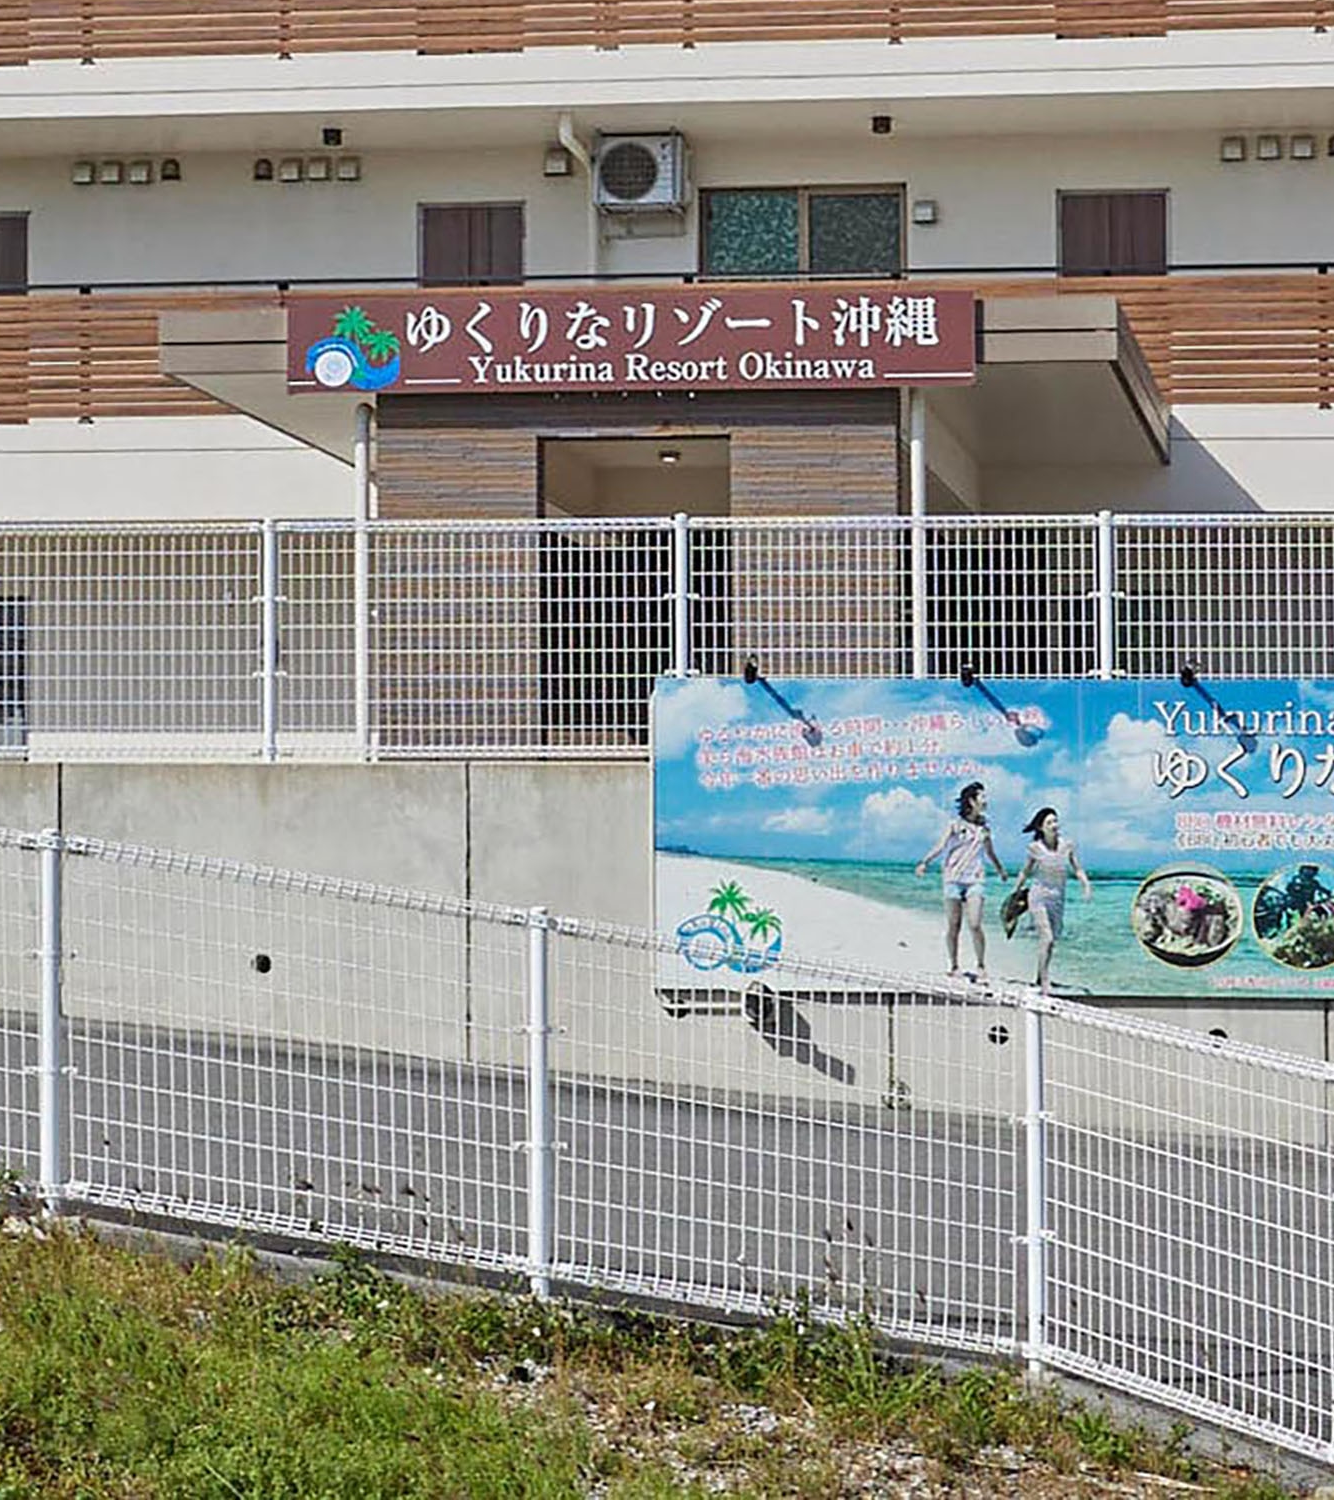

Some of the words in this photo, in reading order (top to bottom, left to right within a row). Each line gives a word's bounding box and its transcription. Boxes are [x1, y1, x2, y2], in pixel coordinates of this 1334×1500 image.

[406, 297, 940, 353] ゆくりなリゾート沖縄
[468, 355, 615, 384] Yukurina
[625, 353, 728, 382] Resort
[738, 351, 876, 380] Okinawa
